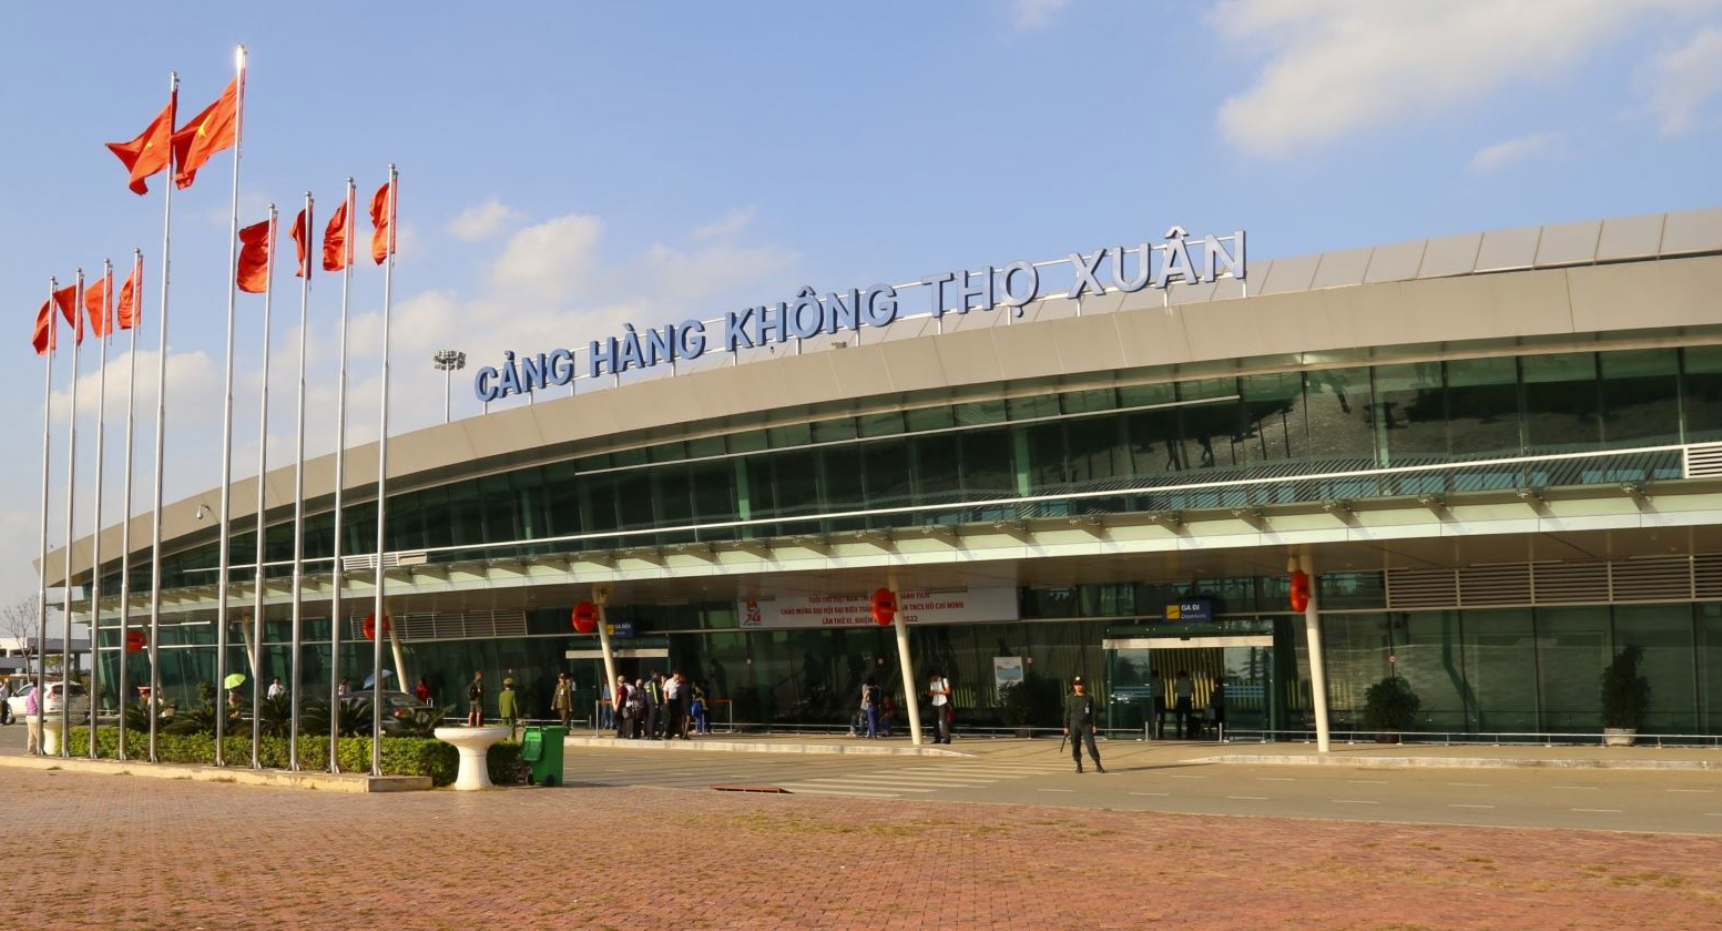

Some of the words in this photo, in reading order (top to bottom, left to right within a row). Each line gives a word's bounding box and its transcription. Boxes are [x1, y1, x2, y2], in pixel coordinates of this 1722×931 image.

[474, 350, 574, 402] CẢNG
[589, 322, 706, 379] HÀNG
[724, 285, 897, 350] KHÔNG
[921, 259, 1040, 318] THỌ
[1067, 225, 1247, 299] XUÂN
[1181, 604, 1191, 612] GA
